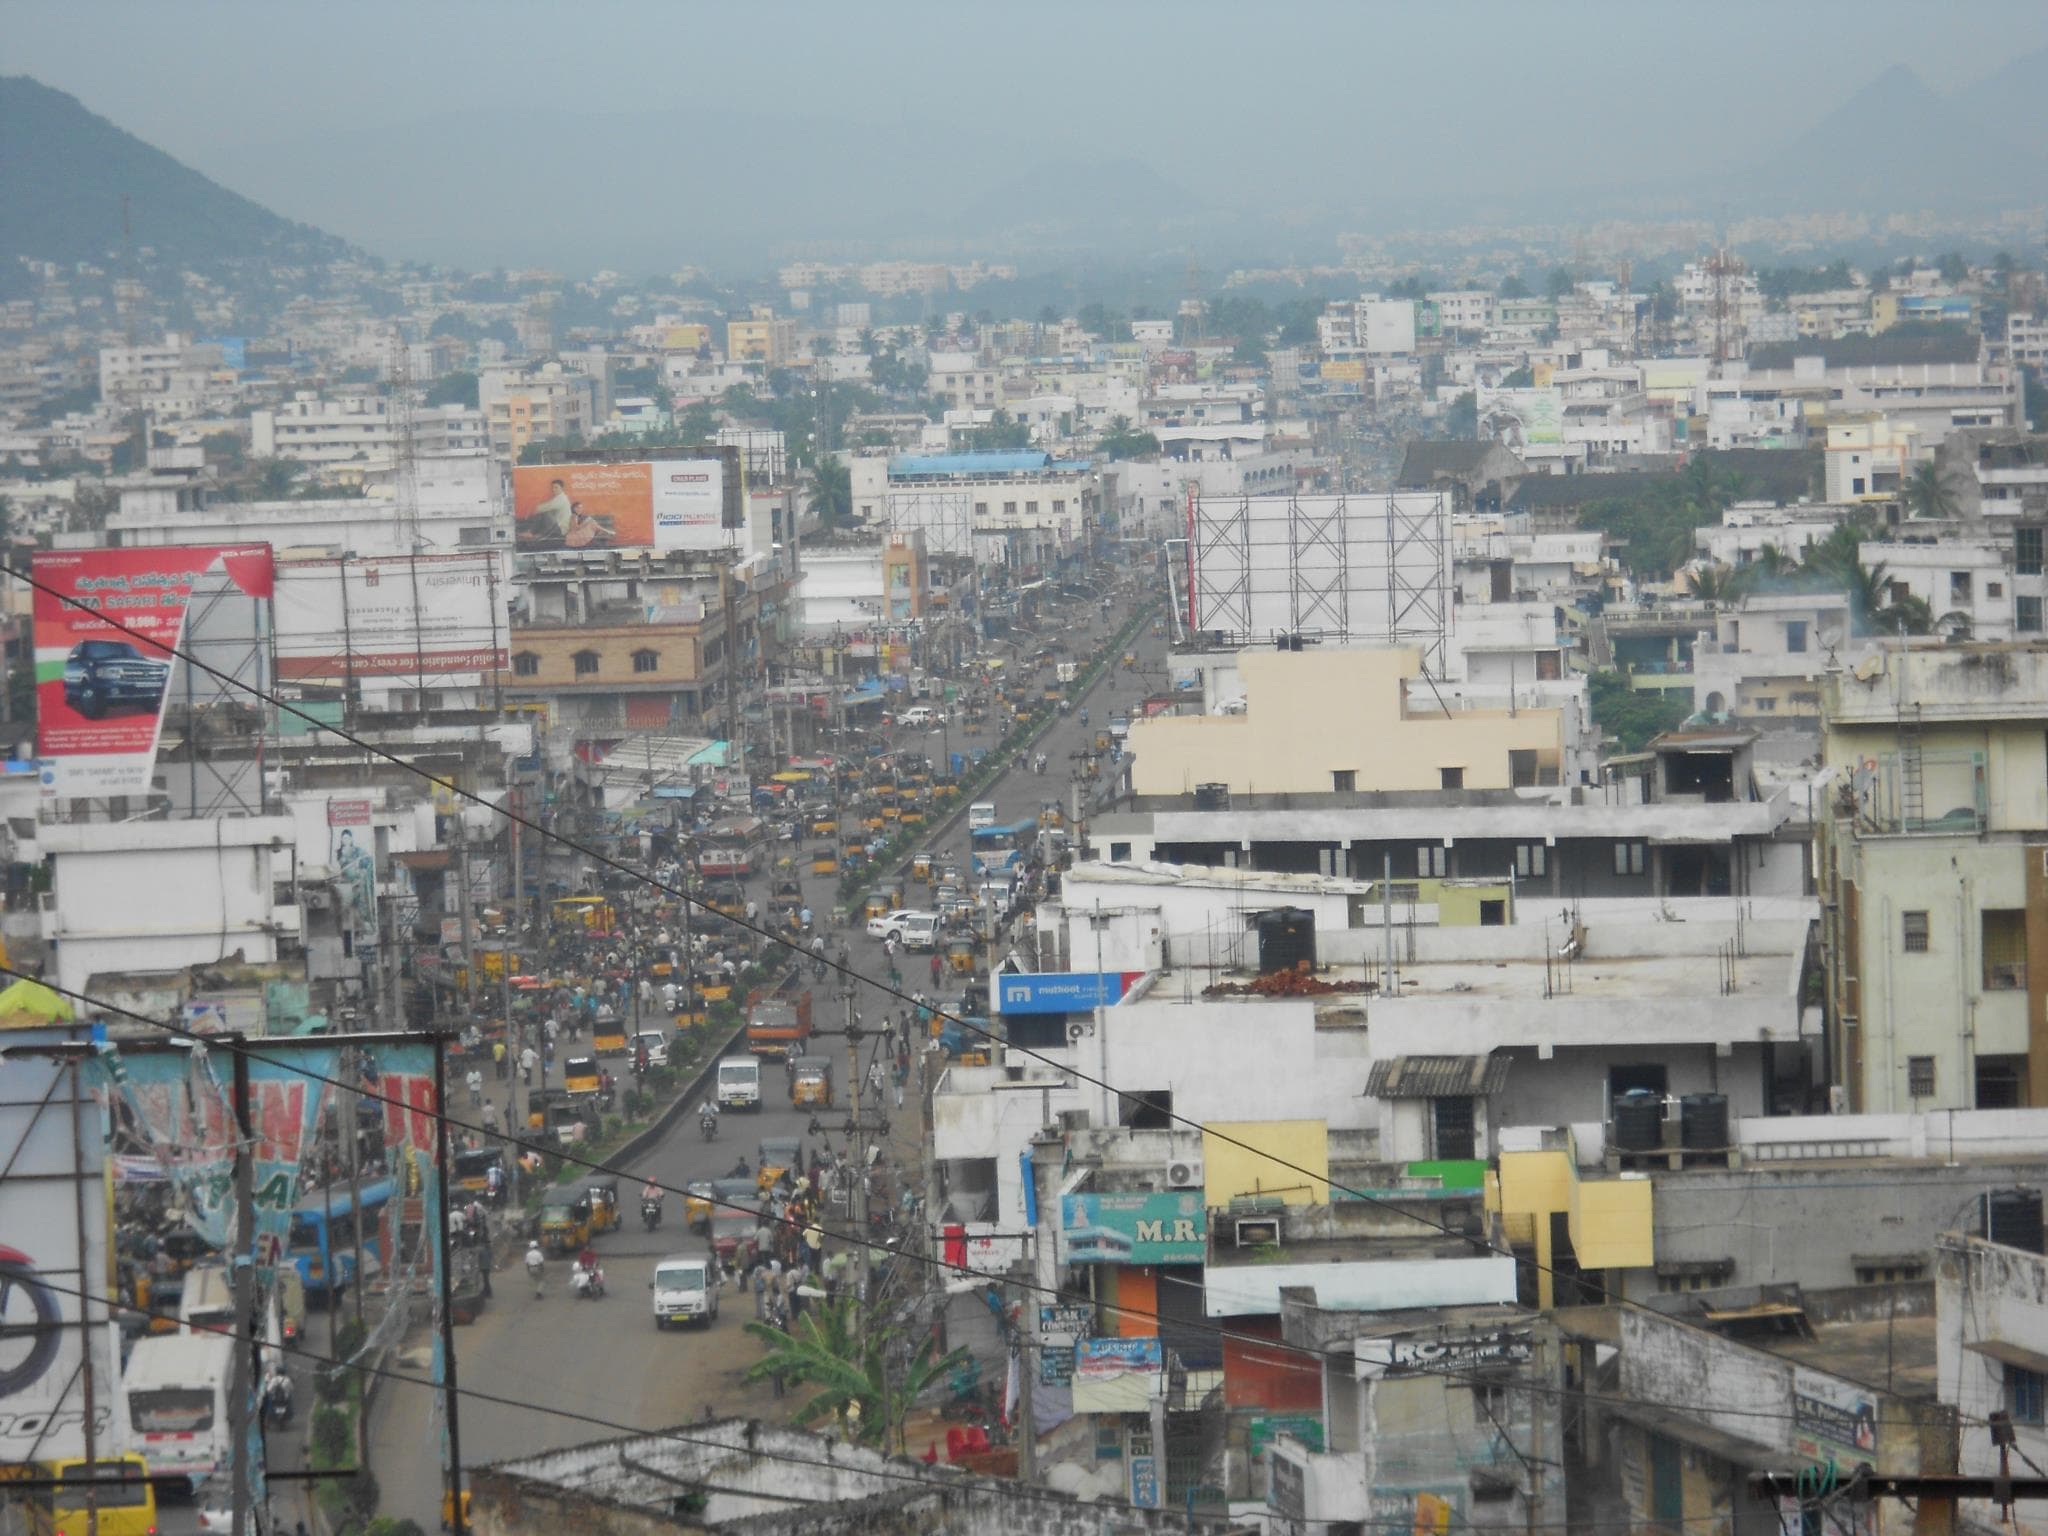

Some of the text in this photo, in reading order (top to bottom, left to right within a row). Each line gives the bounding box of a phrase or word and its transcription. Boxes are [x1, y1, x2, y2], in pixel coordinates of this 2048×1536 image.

[425, 574, 481, 589] University
[105, 595, 158, 608] SAFARI
[373, 656, 397, 668] every
[400, 657, 414, 669] for
[1038, 984, 1080, 995] muthoot
[1135, 1219, 1207, 1242] M.R.
